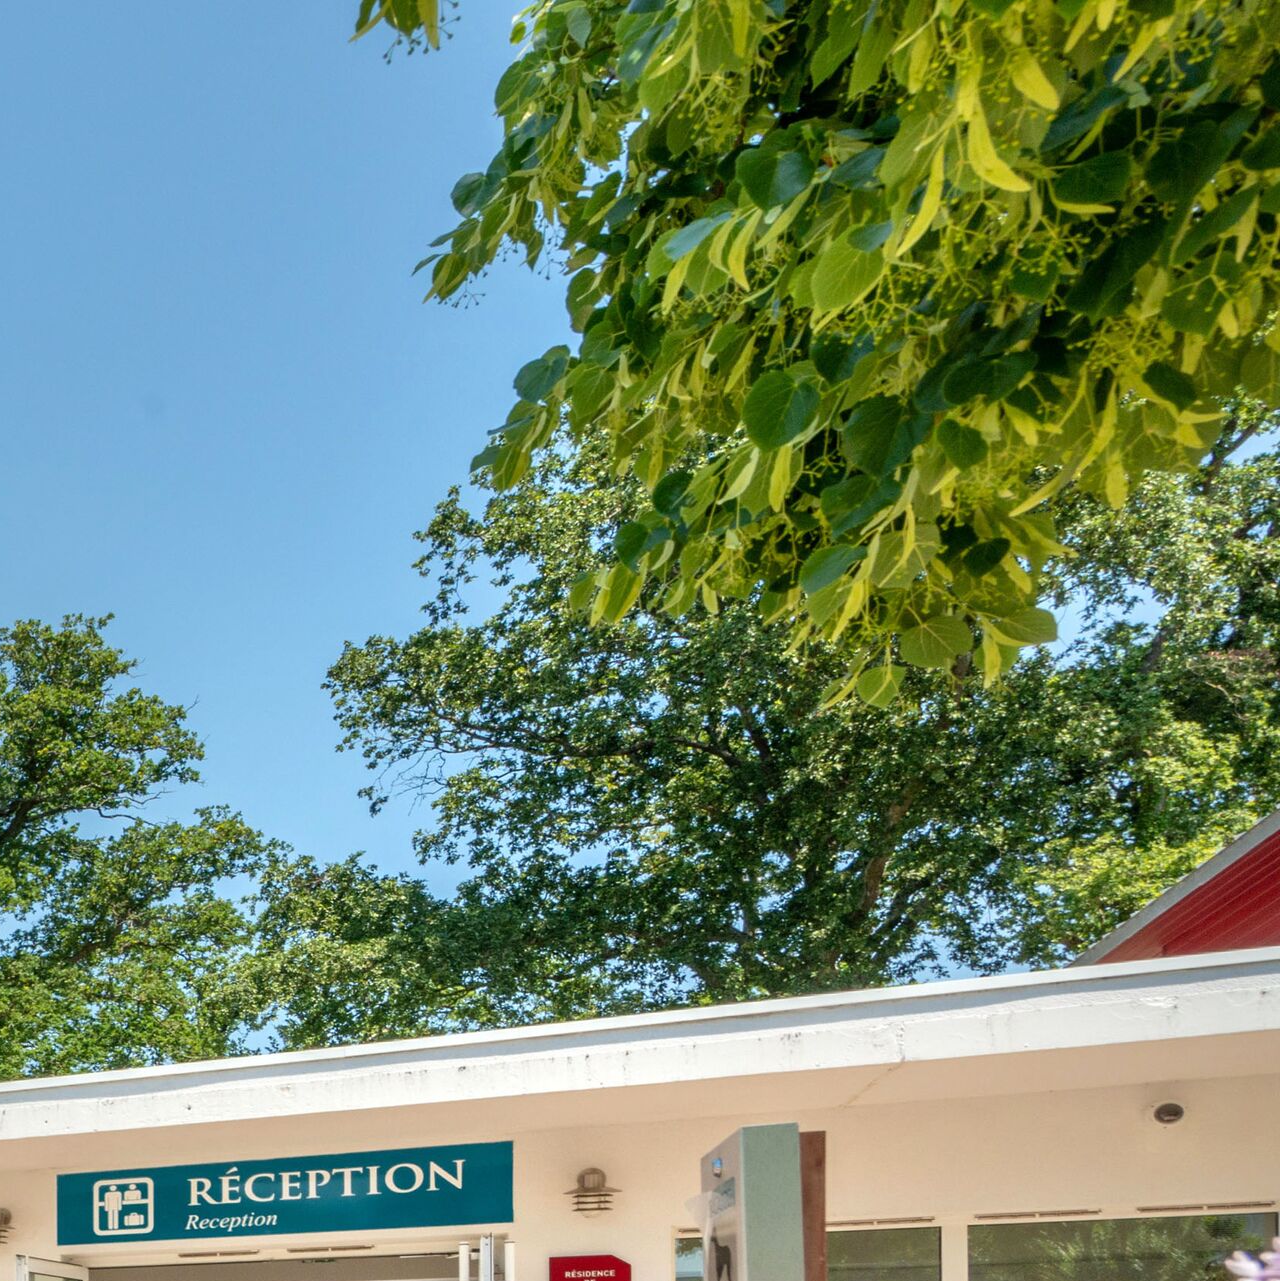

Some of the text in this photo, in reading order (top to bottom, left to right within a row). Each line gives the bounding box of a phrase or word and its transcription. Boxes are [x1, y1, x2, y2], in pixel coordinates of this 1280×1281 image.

[186, 1159, 466, 1207] RÉCEPTION
[185, 1212, 278, 1232] Reception
[564, 1269, 616, 1278] RÉSIDENCE
